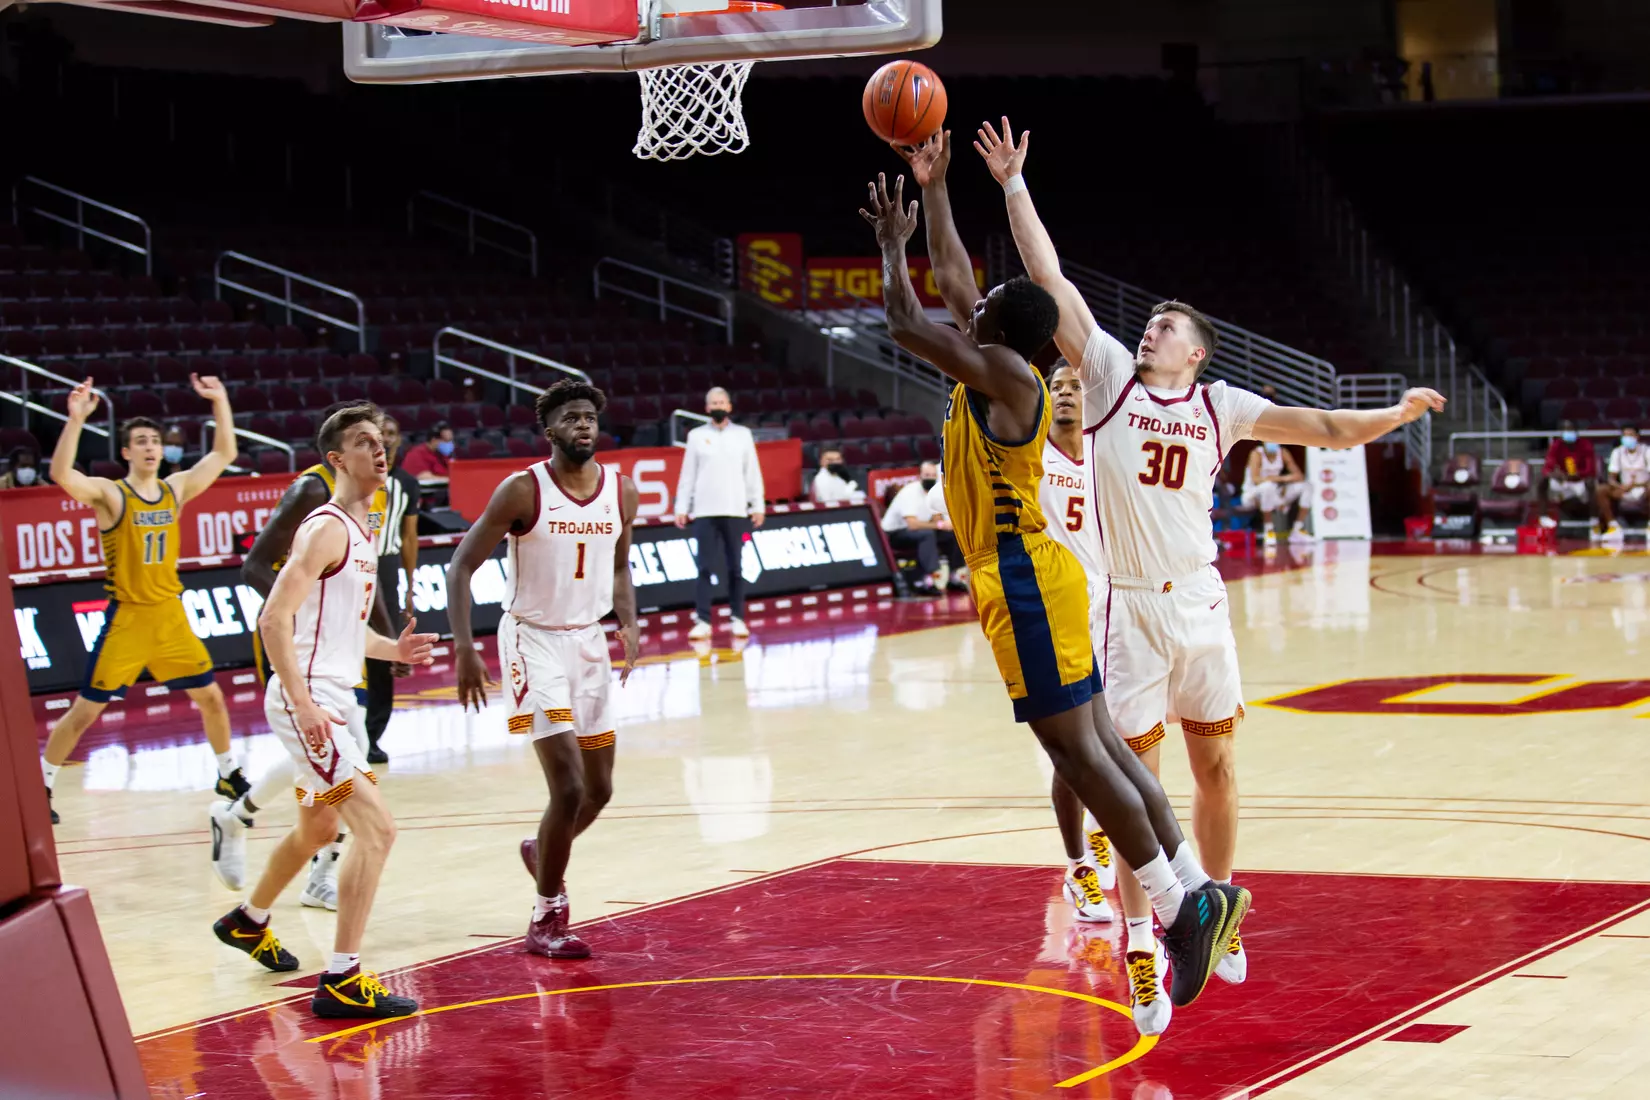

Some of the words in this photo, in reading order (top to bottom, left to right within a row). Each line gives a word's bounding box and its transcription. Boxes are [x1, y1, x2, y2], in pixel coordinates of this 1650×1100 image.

[1128, 412, 1208, 441] TROJANS
[1048, 473, 1084, 490] TROJ
[1138, 440, 1189, 491] 30
[548, 521, 613, 535] TROJANS
[1066, 496, 1085, 532] 5
[17, 521, 75, 570] DOS
[143, 530, 168, 565] 11
[574, 542, 586, 580] 1
